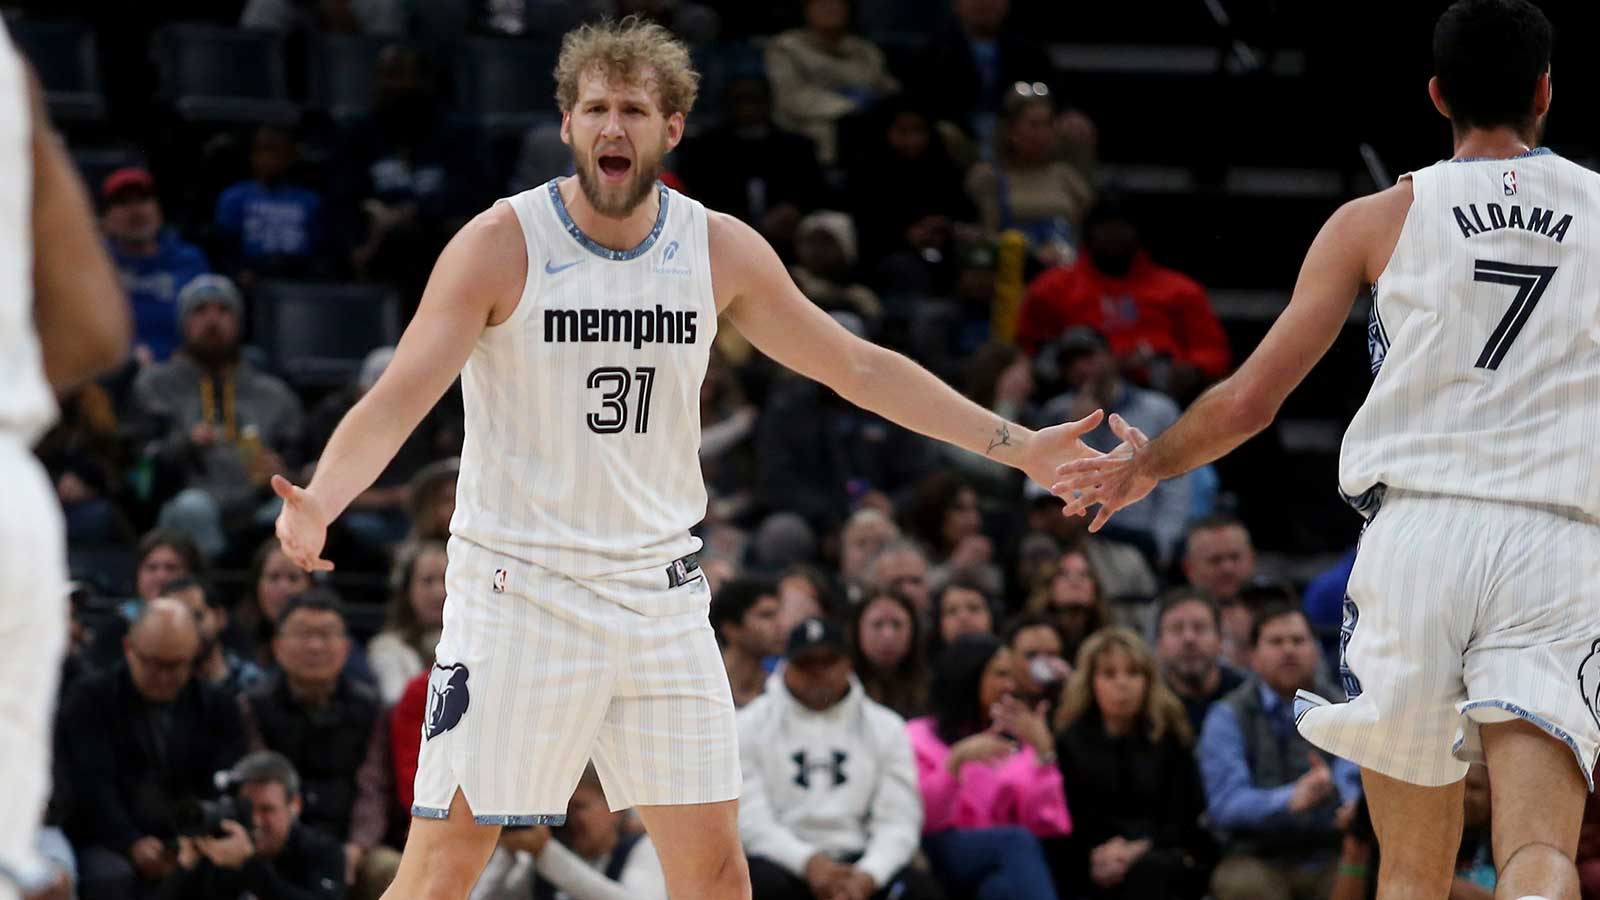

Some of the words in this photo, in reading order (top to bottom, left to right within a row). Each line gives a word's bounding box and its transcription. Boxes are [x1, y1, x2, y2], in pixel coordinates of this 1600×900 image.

[1453, 203, 1573, 243] ALDAMA
[544, 304, 697, 349] memphis
[1474, 259, 1558, 370] 7
[586, 366, 656, 434] 31
